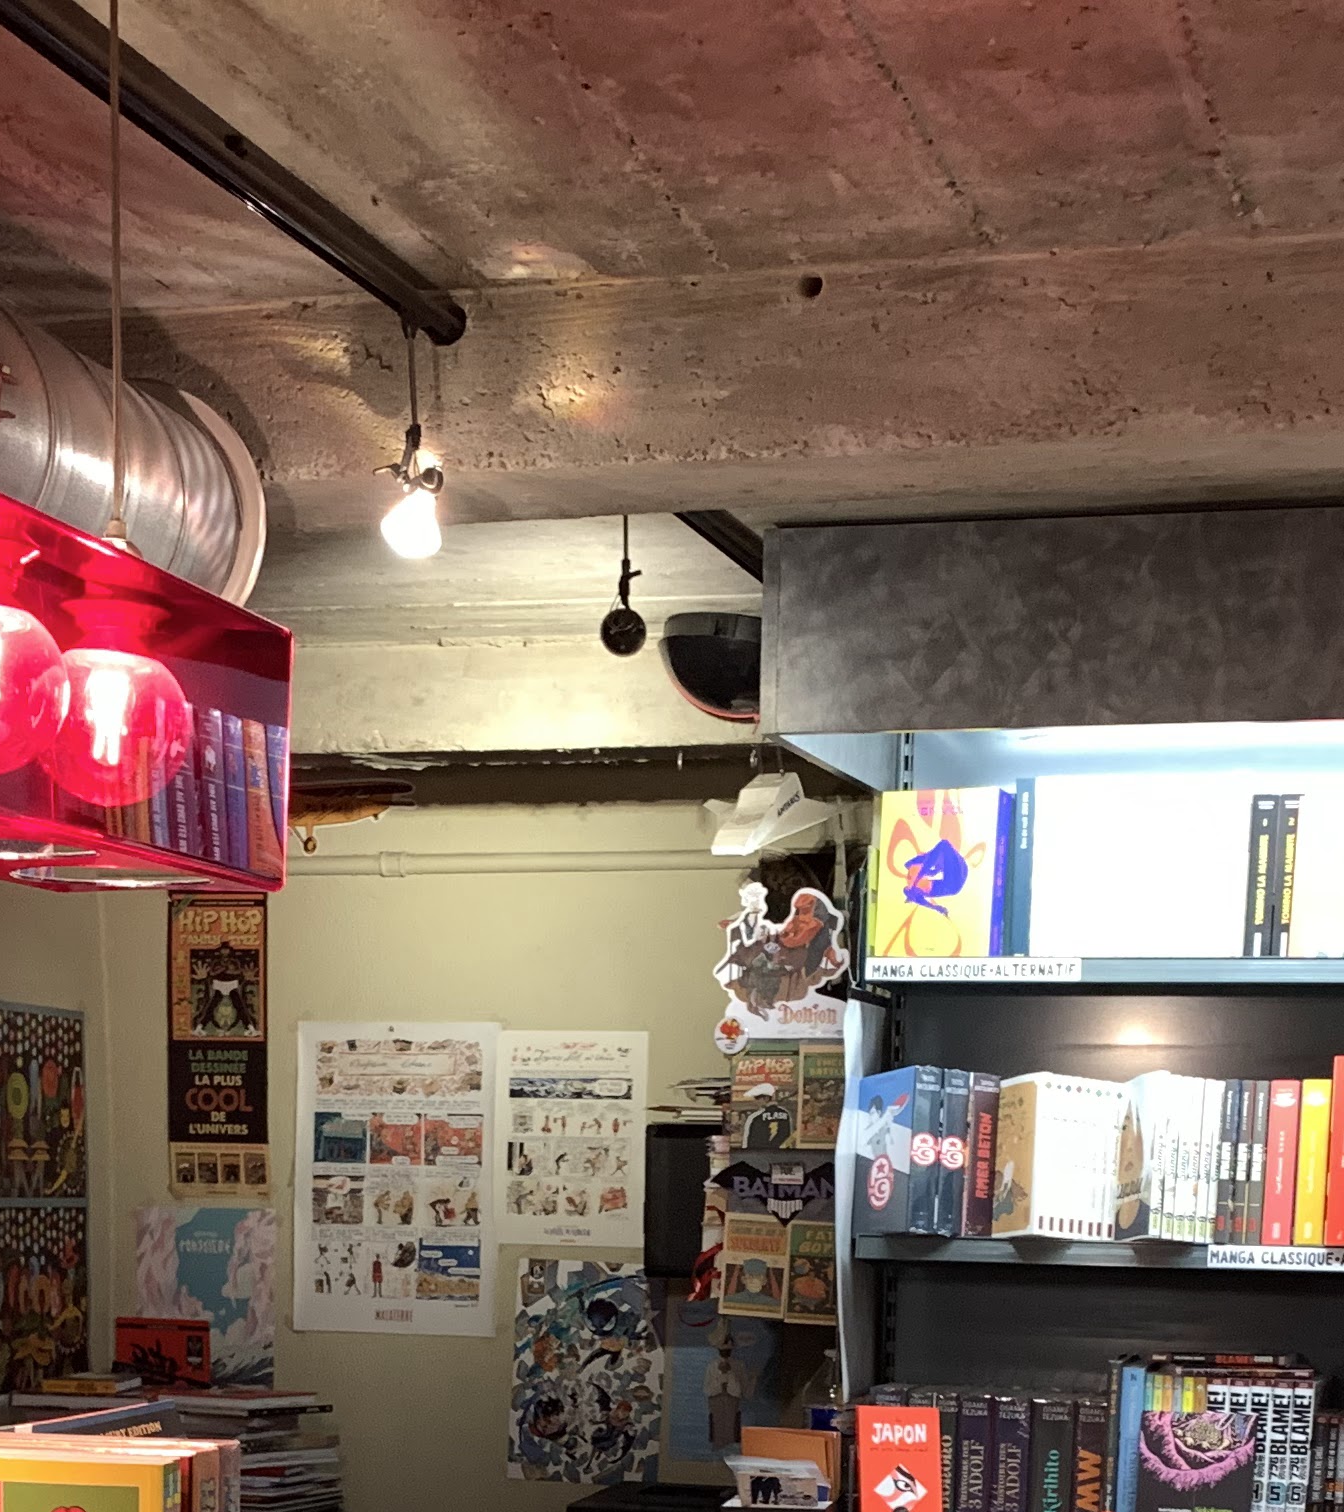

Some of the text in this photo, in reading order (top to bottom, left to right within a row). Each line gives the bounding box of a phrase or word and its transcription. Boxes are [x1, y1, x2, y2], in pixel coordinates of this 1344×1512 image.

[872, 963, 914, 979] MANGA
[778, 1003, 837, 1028] Donjon
[194, 1075, 243, 1086] LA PLUS
[185, 1088, 253, 1112] COOL
[211, 1111, 226, 1122] DE
[763, 1112, 788, 1122] FLASH
[189, 1123, 249, 1136] L'UNIVERS
[732, 1175, 835, 1199] BATMAN
[1210, 1250, 1255, 1267] MANGA
[872, 1423, 927, 1445] JAPON
[1271, 1394, 1291, 1455] BLAME!
[1293, 1393, 1312, 1455] BLAME!
[969, 1440, 984, 1496] ADOLF
[1006, 1443, 1021, 1500] ADOLF
[1076, 1448, 1102, 1512] MW
[1269, 1486, 1281, 1501] 5
[1289, 1486, 1301, 1501] 6
